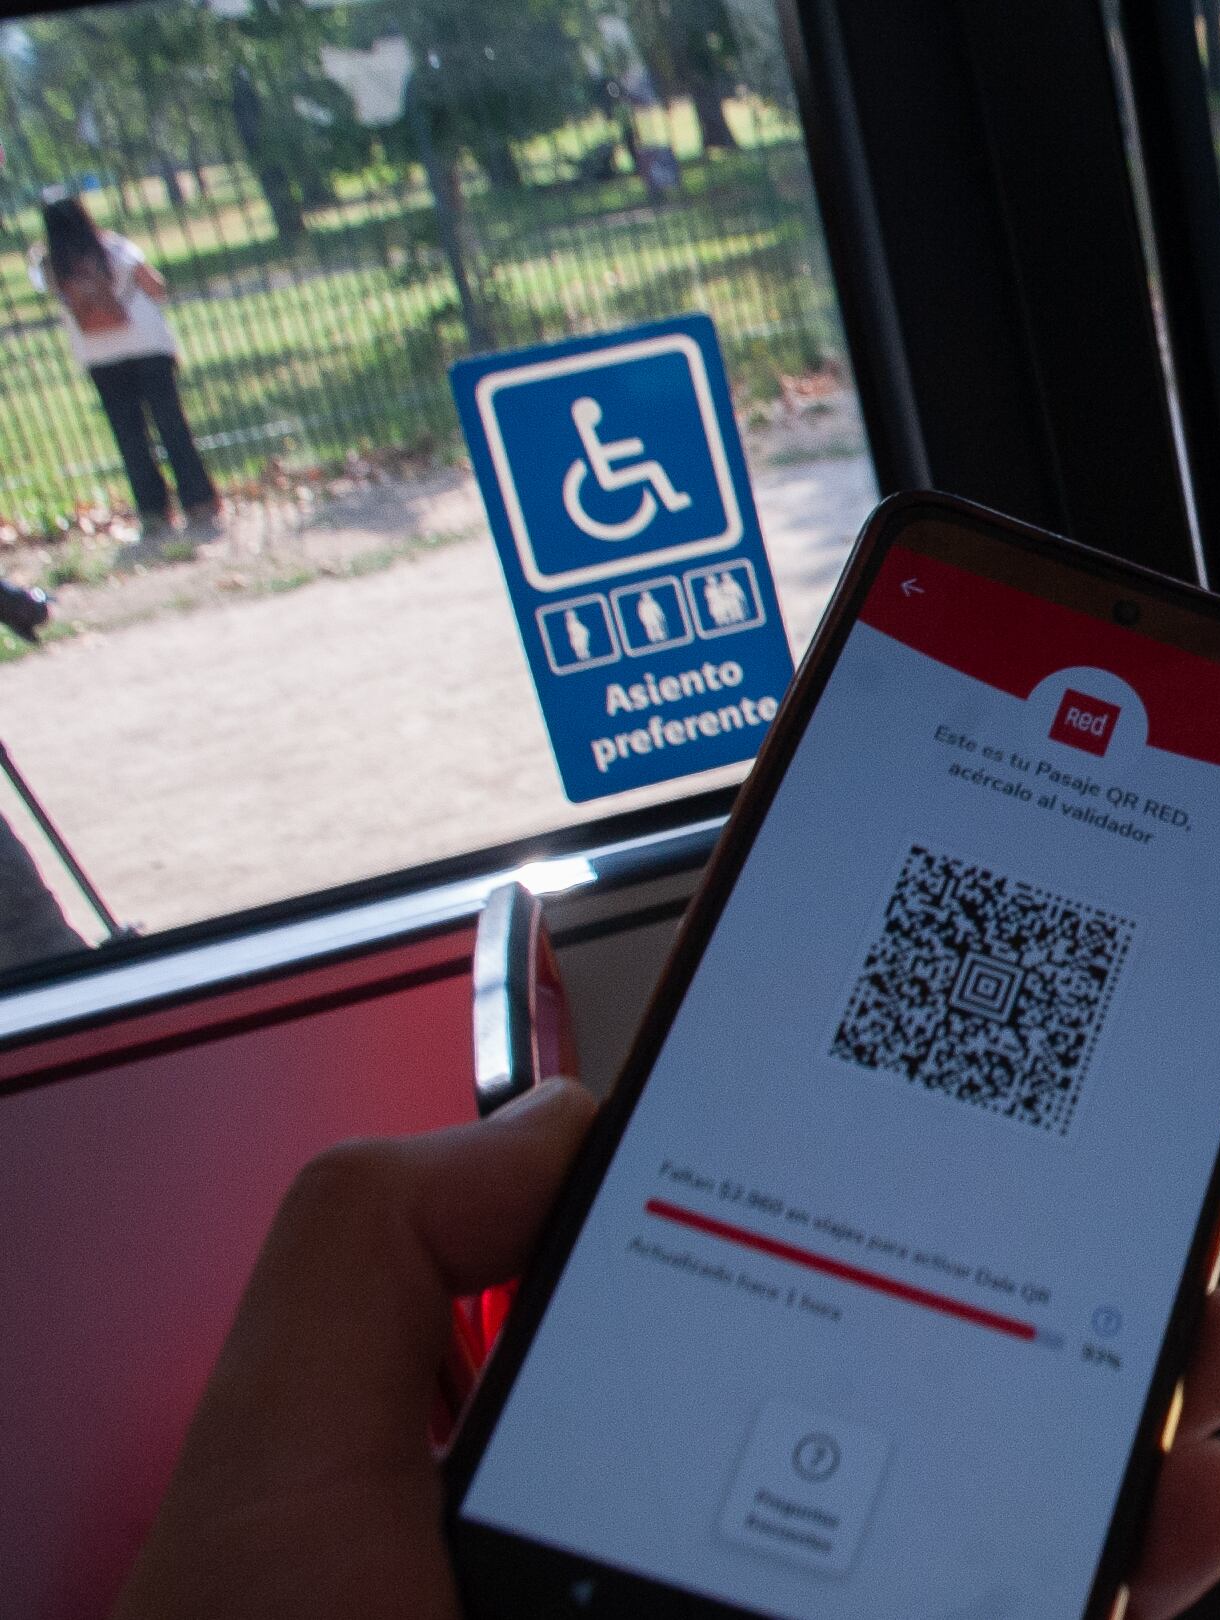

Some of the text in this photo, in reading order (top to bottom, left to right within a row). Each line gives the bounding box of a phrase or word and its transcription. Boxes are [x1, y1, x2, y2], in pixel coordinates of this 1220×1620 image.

[606, 660, 743, 716] Asiento
[590, 696, 778, 772] preferente
[934, 724, 1192, 831] Este es tu Pasaje QR RED,
[948, 762, 1154, 843] acércalo al validador
